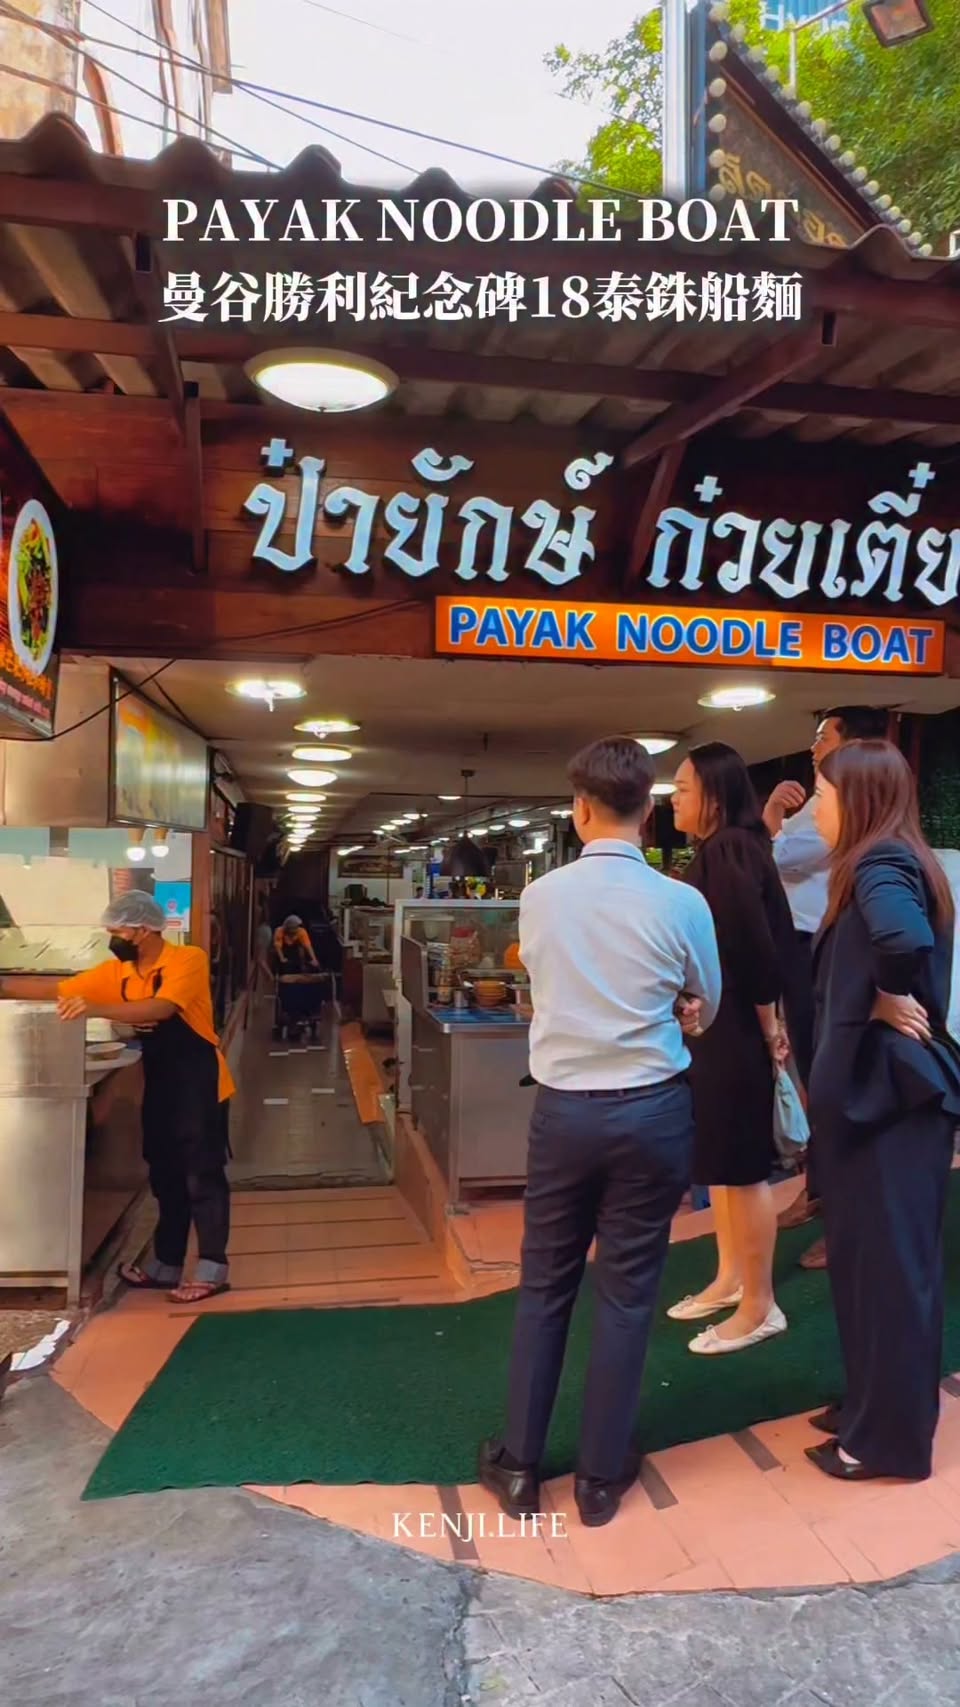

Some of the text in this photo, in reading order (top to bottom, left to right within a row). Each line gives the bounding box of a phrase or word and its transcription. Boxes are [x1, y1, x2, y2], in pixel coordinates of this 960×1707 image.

[243, 438, 614, 586] ป๋ายักษ์
[448, 605, 935, 665] PAYAK NOODLE BOAT
